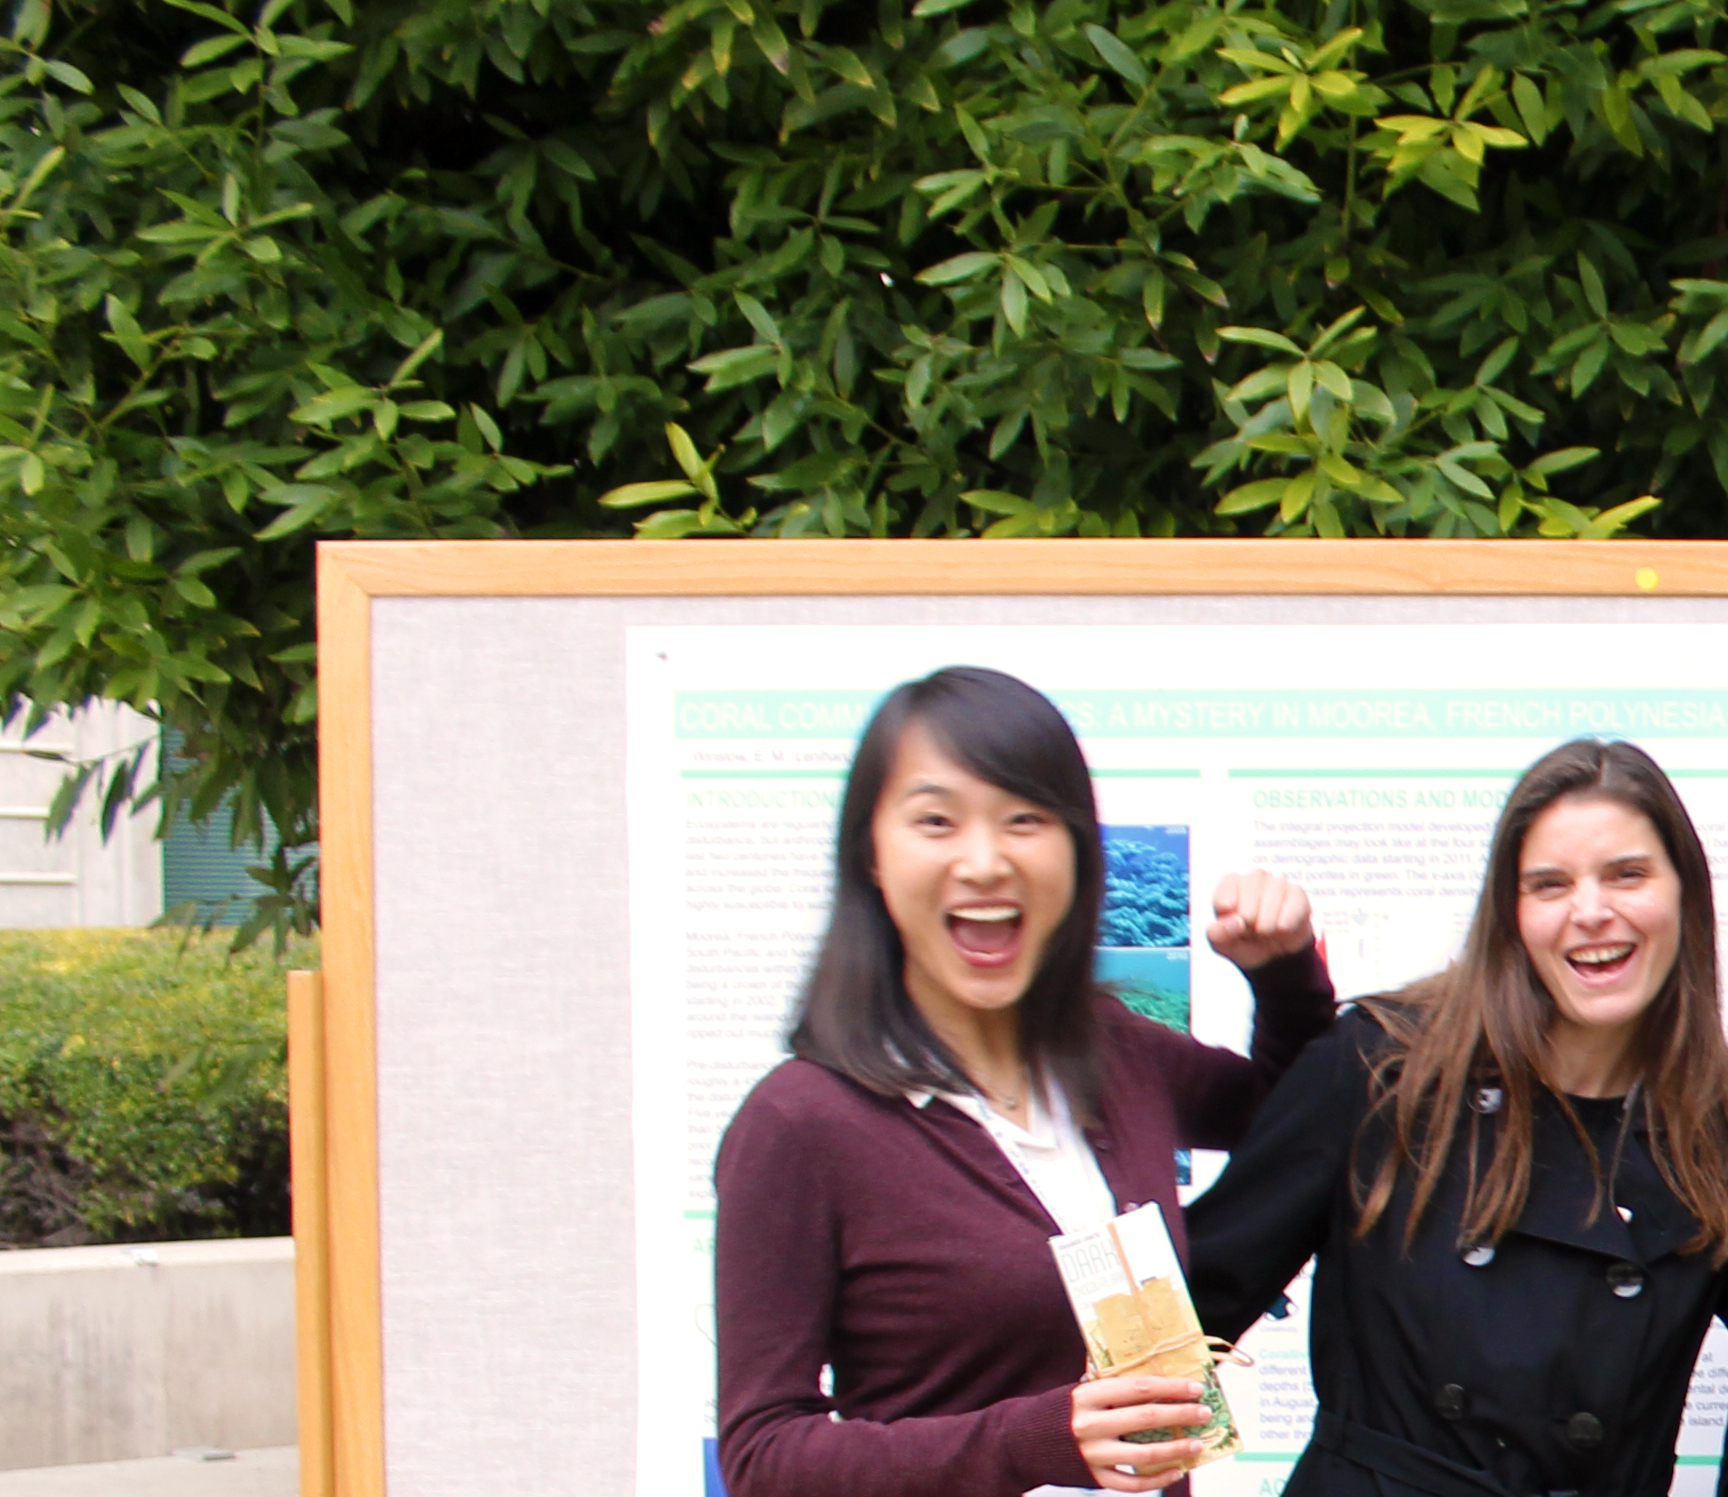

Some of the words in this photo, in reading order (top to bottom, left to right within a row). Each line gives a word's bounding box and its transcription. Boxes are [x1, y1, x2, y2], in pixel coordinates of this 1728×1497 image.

[680, 702, 772, 730] CORAL
[779, 702, 869, 730] COMM
[1108, 702, 1129, 729] A
[1132, 701, 1265, 729] MYSTERY
[1273, 701, 1299, 728] IN
[1445, 701, 1561, 728] FRENCH
[1569, 700, 1727, 728] POLYNESIA
[685, 790, 837, 808] INTRODUCTION
[1253, 789, 1408, 809] OBSERVATIONS
[1414, 789, 1456, 808] AND
[1254, 821, 1276, 831] The
[1306, 887, 1336, 897] -axis
[1060, 1238, 1120, 1283] DARK
